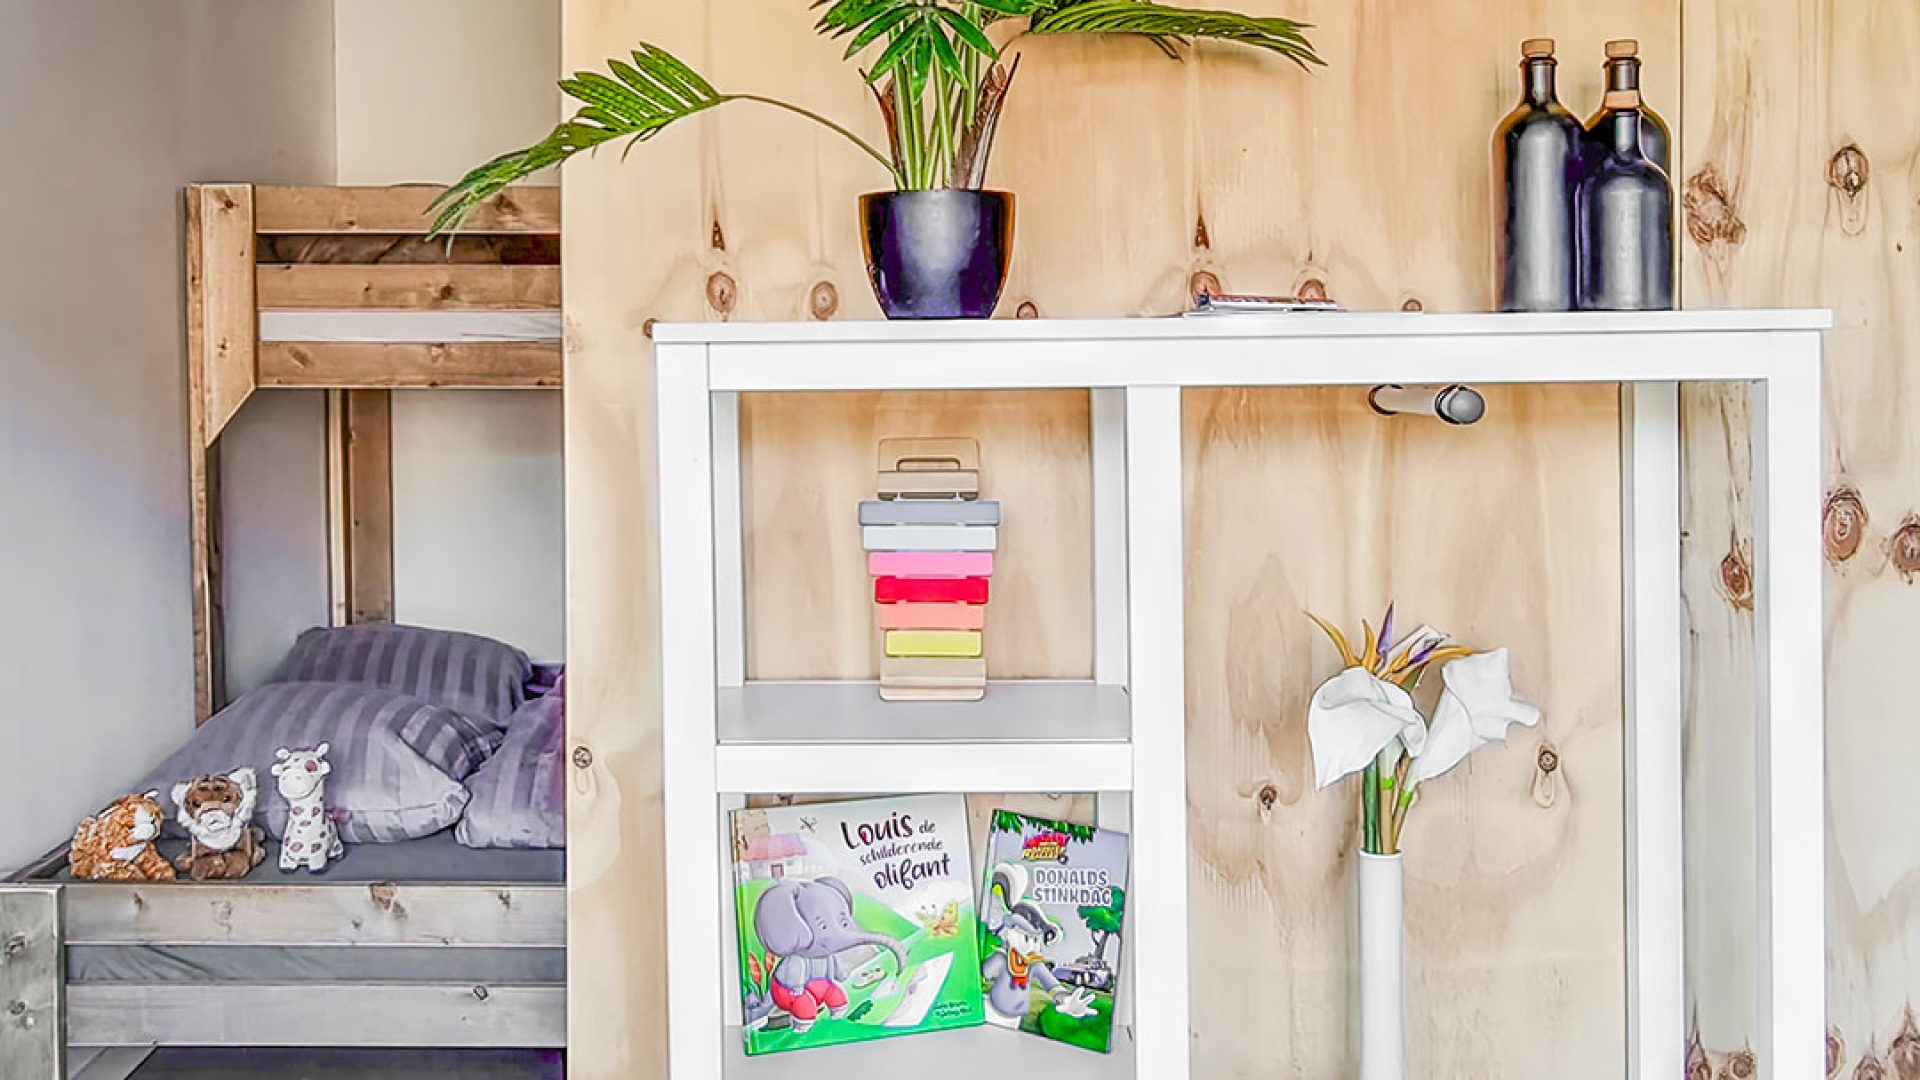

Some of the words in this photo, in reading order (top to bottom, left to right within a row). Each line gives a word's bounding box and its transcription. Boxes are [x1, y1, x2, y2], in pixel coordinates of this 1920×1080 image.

[841, 811, 914, 849] Louis
[919, 820, 935, 833] de
[860, 838, 943, 865] schilderende
[874, 853, 950, 890] olifant
[1035, 869, 1108, 885] DONALDS
[1034, 887, 1110, 904] STINKDAG
